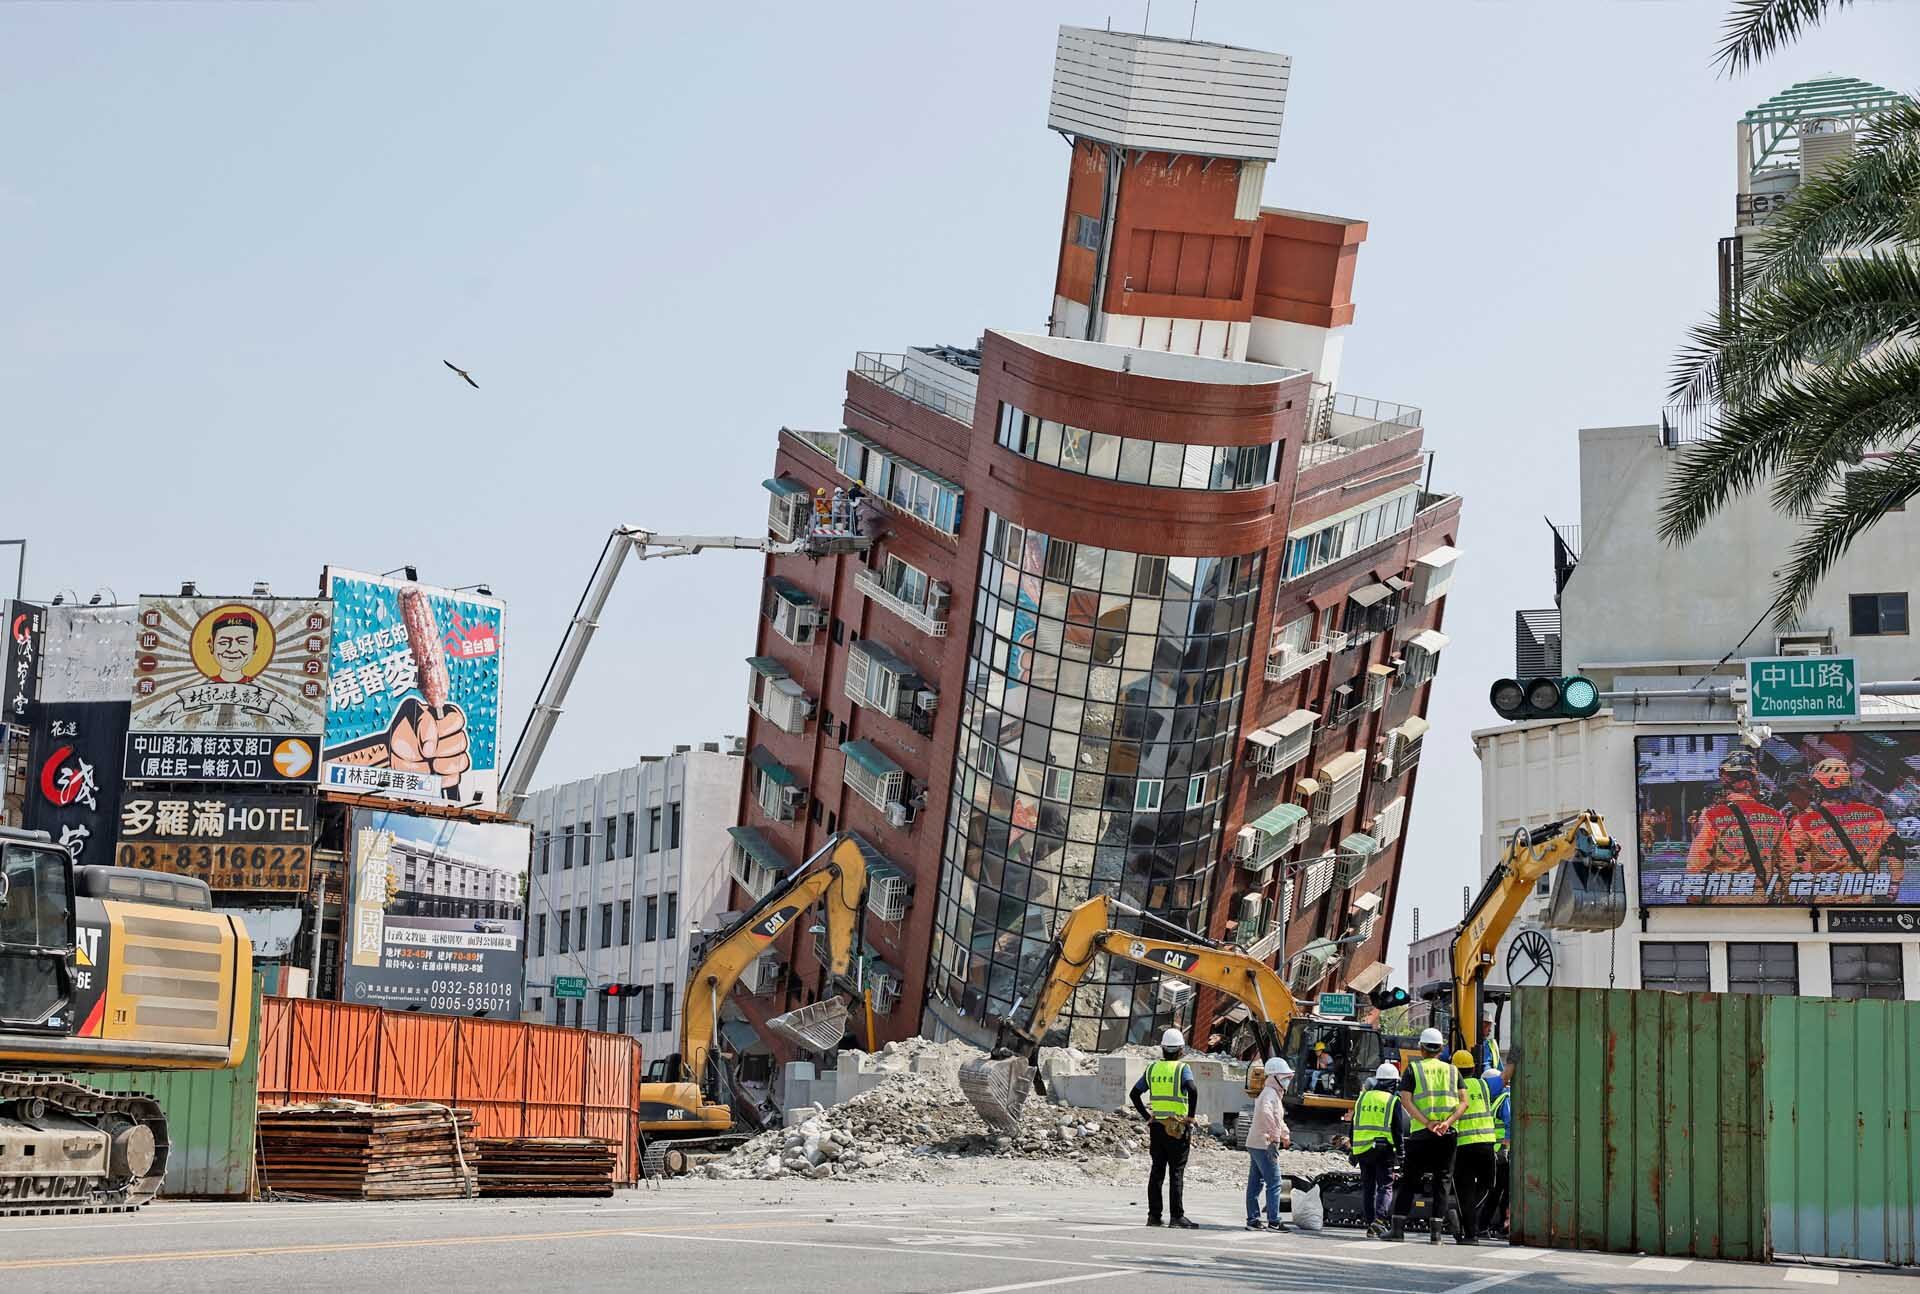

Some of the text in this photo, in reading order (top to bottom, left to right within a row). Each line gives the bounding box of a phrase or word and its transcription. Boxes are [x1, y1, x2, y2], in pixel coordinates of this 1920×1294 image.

[338, 623, 409, 662] 最好吃的
[305, 617, 323, 697] 別無分號
[327, 647, 419, 712] 燒番麥
[1761, 663, 1844, 688] 中山路
[1761, 695, 1846, 714] Zhongshan Rd.
[134, 736, 272, 757] 中山路北濱街交叉路口
[140, 757, 262, 778] (原住民一條街入口)
[348, 767, 420, 791] 林記燒番麥
[121, 799, 310, 838] 多羅滿 HOTEL
[119, 844, 306, 870] 03-8316622
[1656, 873, 1757, 896] 不要放棄
[1788, 873, 1892, 896] 花蓮加油
[764, 911, 787, 934] CAT
[76, 927, 102, 966] AT
[1164, 950, 1187, 970] CAT
[77, 971, 91, 990] 6E
[431, 980, 512, 997] 0932-581018
[430, 996, 511, 1012] 0905-935071
[667, 1109, 684, 1121] CAT
